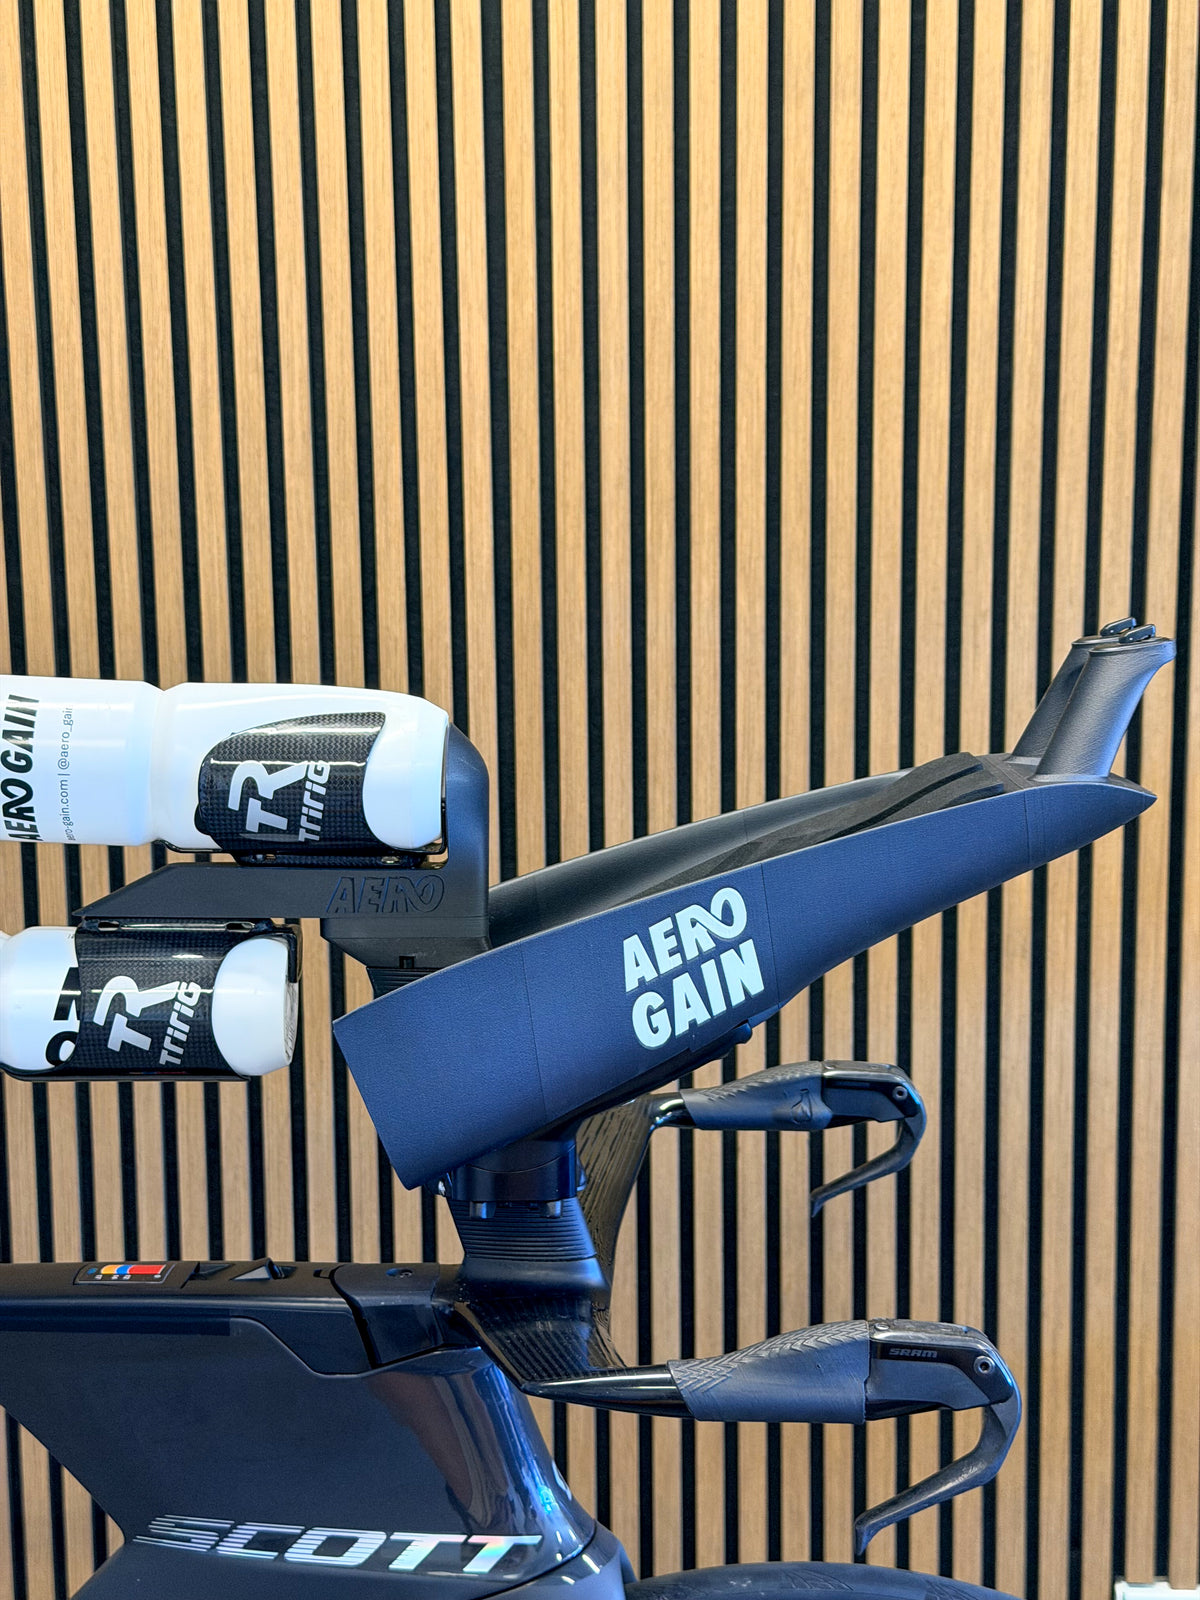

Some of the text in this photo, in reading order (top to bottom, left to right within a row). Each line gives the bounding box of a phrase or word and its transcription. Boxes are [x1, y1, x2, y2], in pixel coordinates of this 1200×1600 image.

[0, 778, 44, 841] AERO
[325, 874, 445, 913] AERO
[623, 887, 747, 993] AERO
[632, 938, 765, 1048] GAIN
[888, 1347, 938, 1359] SRAM
[133, 1514, 542, 1574] SCOTT
